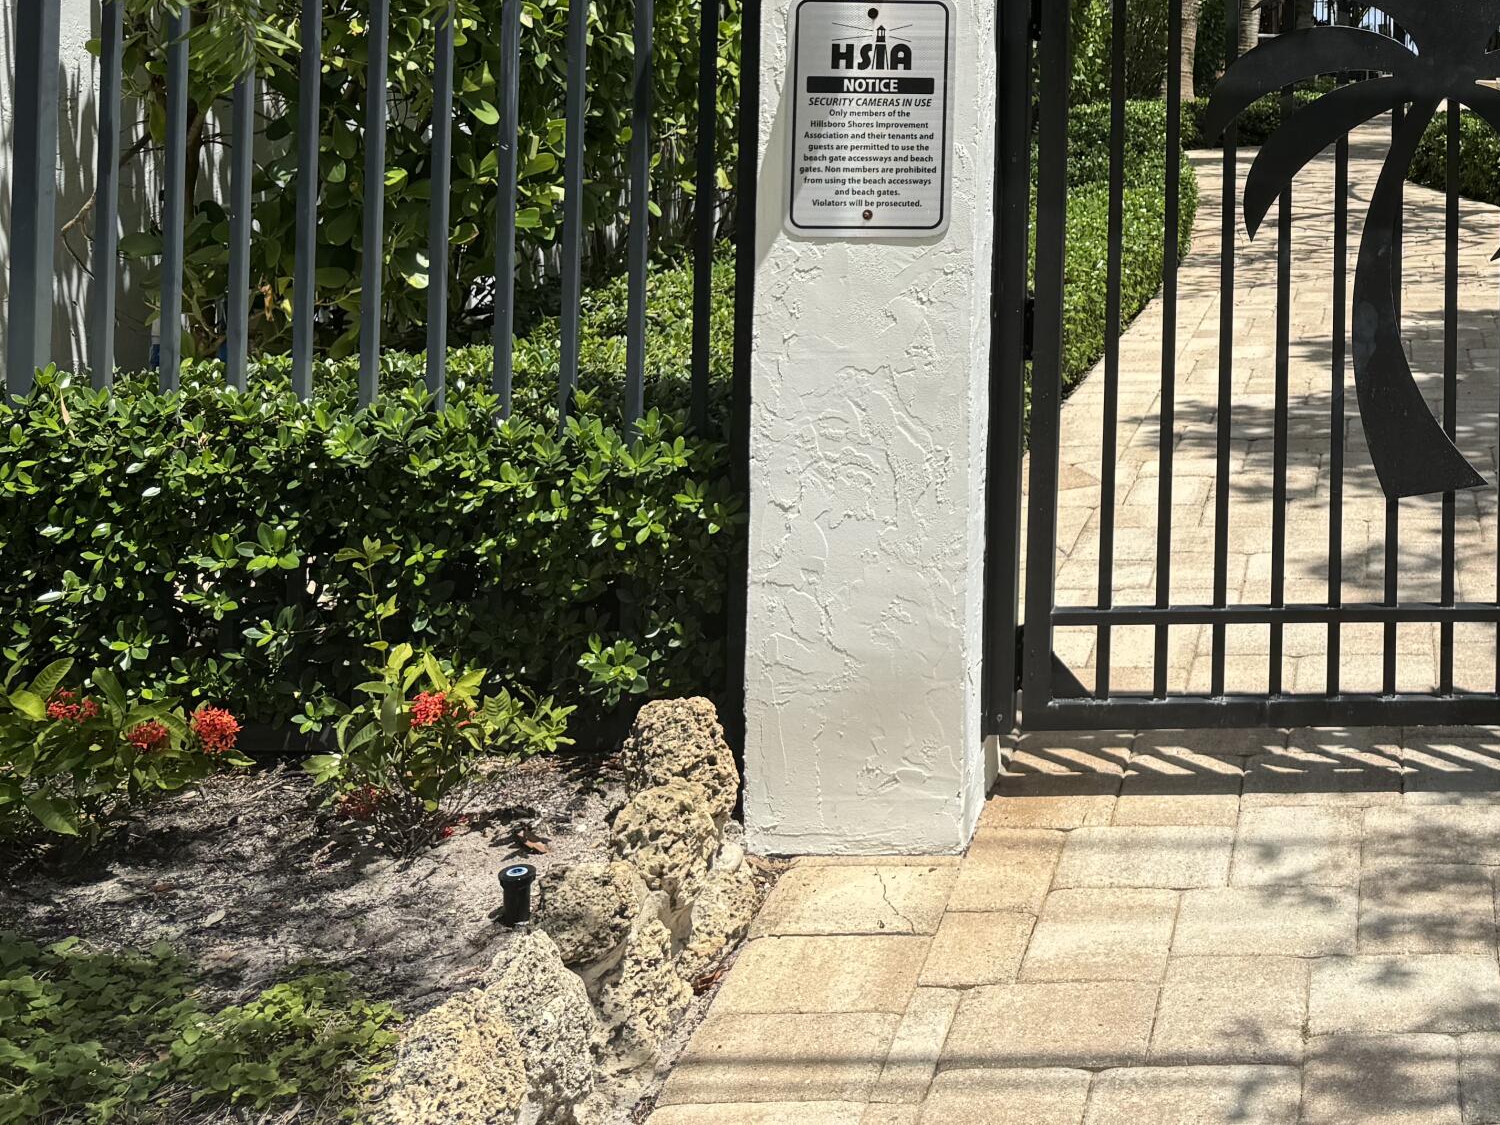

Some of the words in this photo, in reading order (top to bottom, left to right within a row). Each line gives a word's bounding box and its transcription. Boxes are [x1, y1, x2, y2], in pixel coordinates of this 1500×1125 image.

[831, 43, 912, 70] HSIA
[843, 79, 898, 92] NOTICE
[809, 97, 853, 106] SECURITY
[855, 98, 901, 107] CAMERAS
[902, 99, 913, 107] IN
[914, 99, 932, 108] USE
[829, 109, 847, 118] Only
[886, 109, 895, 117] of
[810, 120, 846, 128] Hillsboro
[848, 121, 874, 129] Shores
[876, 121, 928, 131] Improvement
[850, 132, 865, 140] and
[867, 132, 886, 140] their
[808, 144, 834, 153] guests
[850, 143, 889, 153] permitted
[804, 154, 827, 162] beach
[828, 155, 846, 164] gate
[848, 156, 891, 164] accessways
[893, 154, 908, 162] and
[910, 154, 933, 162] beach
[799, 166, 823, 175] gates.
[895, 166, 937, 176] prohibited
[824, 177, 846, 187] using
[848, 177, 861, 185] the
[863, 177, 886, 185] beach
[888, 178, 931, 187] accessways
[835, 188, 850, 196] and
[852, 188, 875, 196] beach
[876, 189, 900, 198] gates.
[812, 199, 847, 207] Violators
[849, 199, 863, 207] will
[876, 200, 922, 210] prosecuted.
